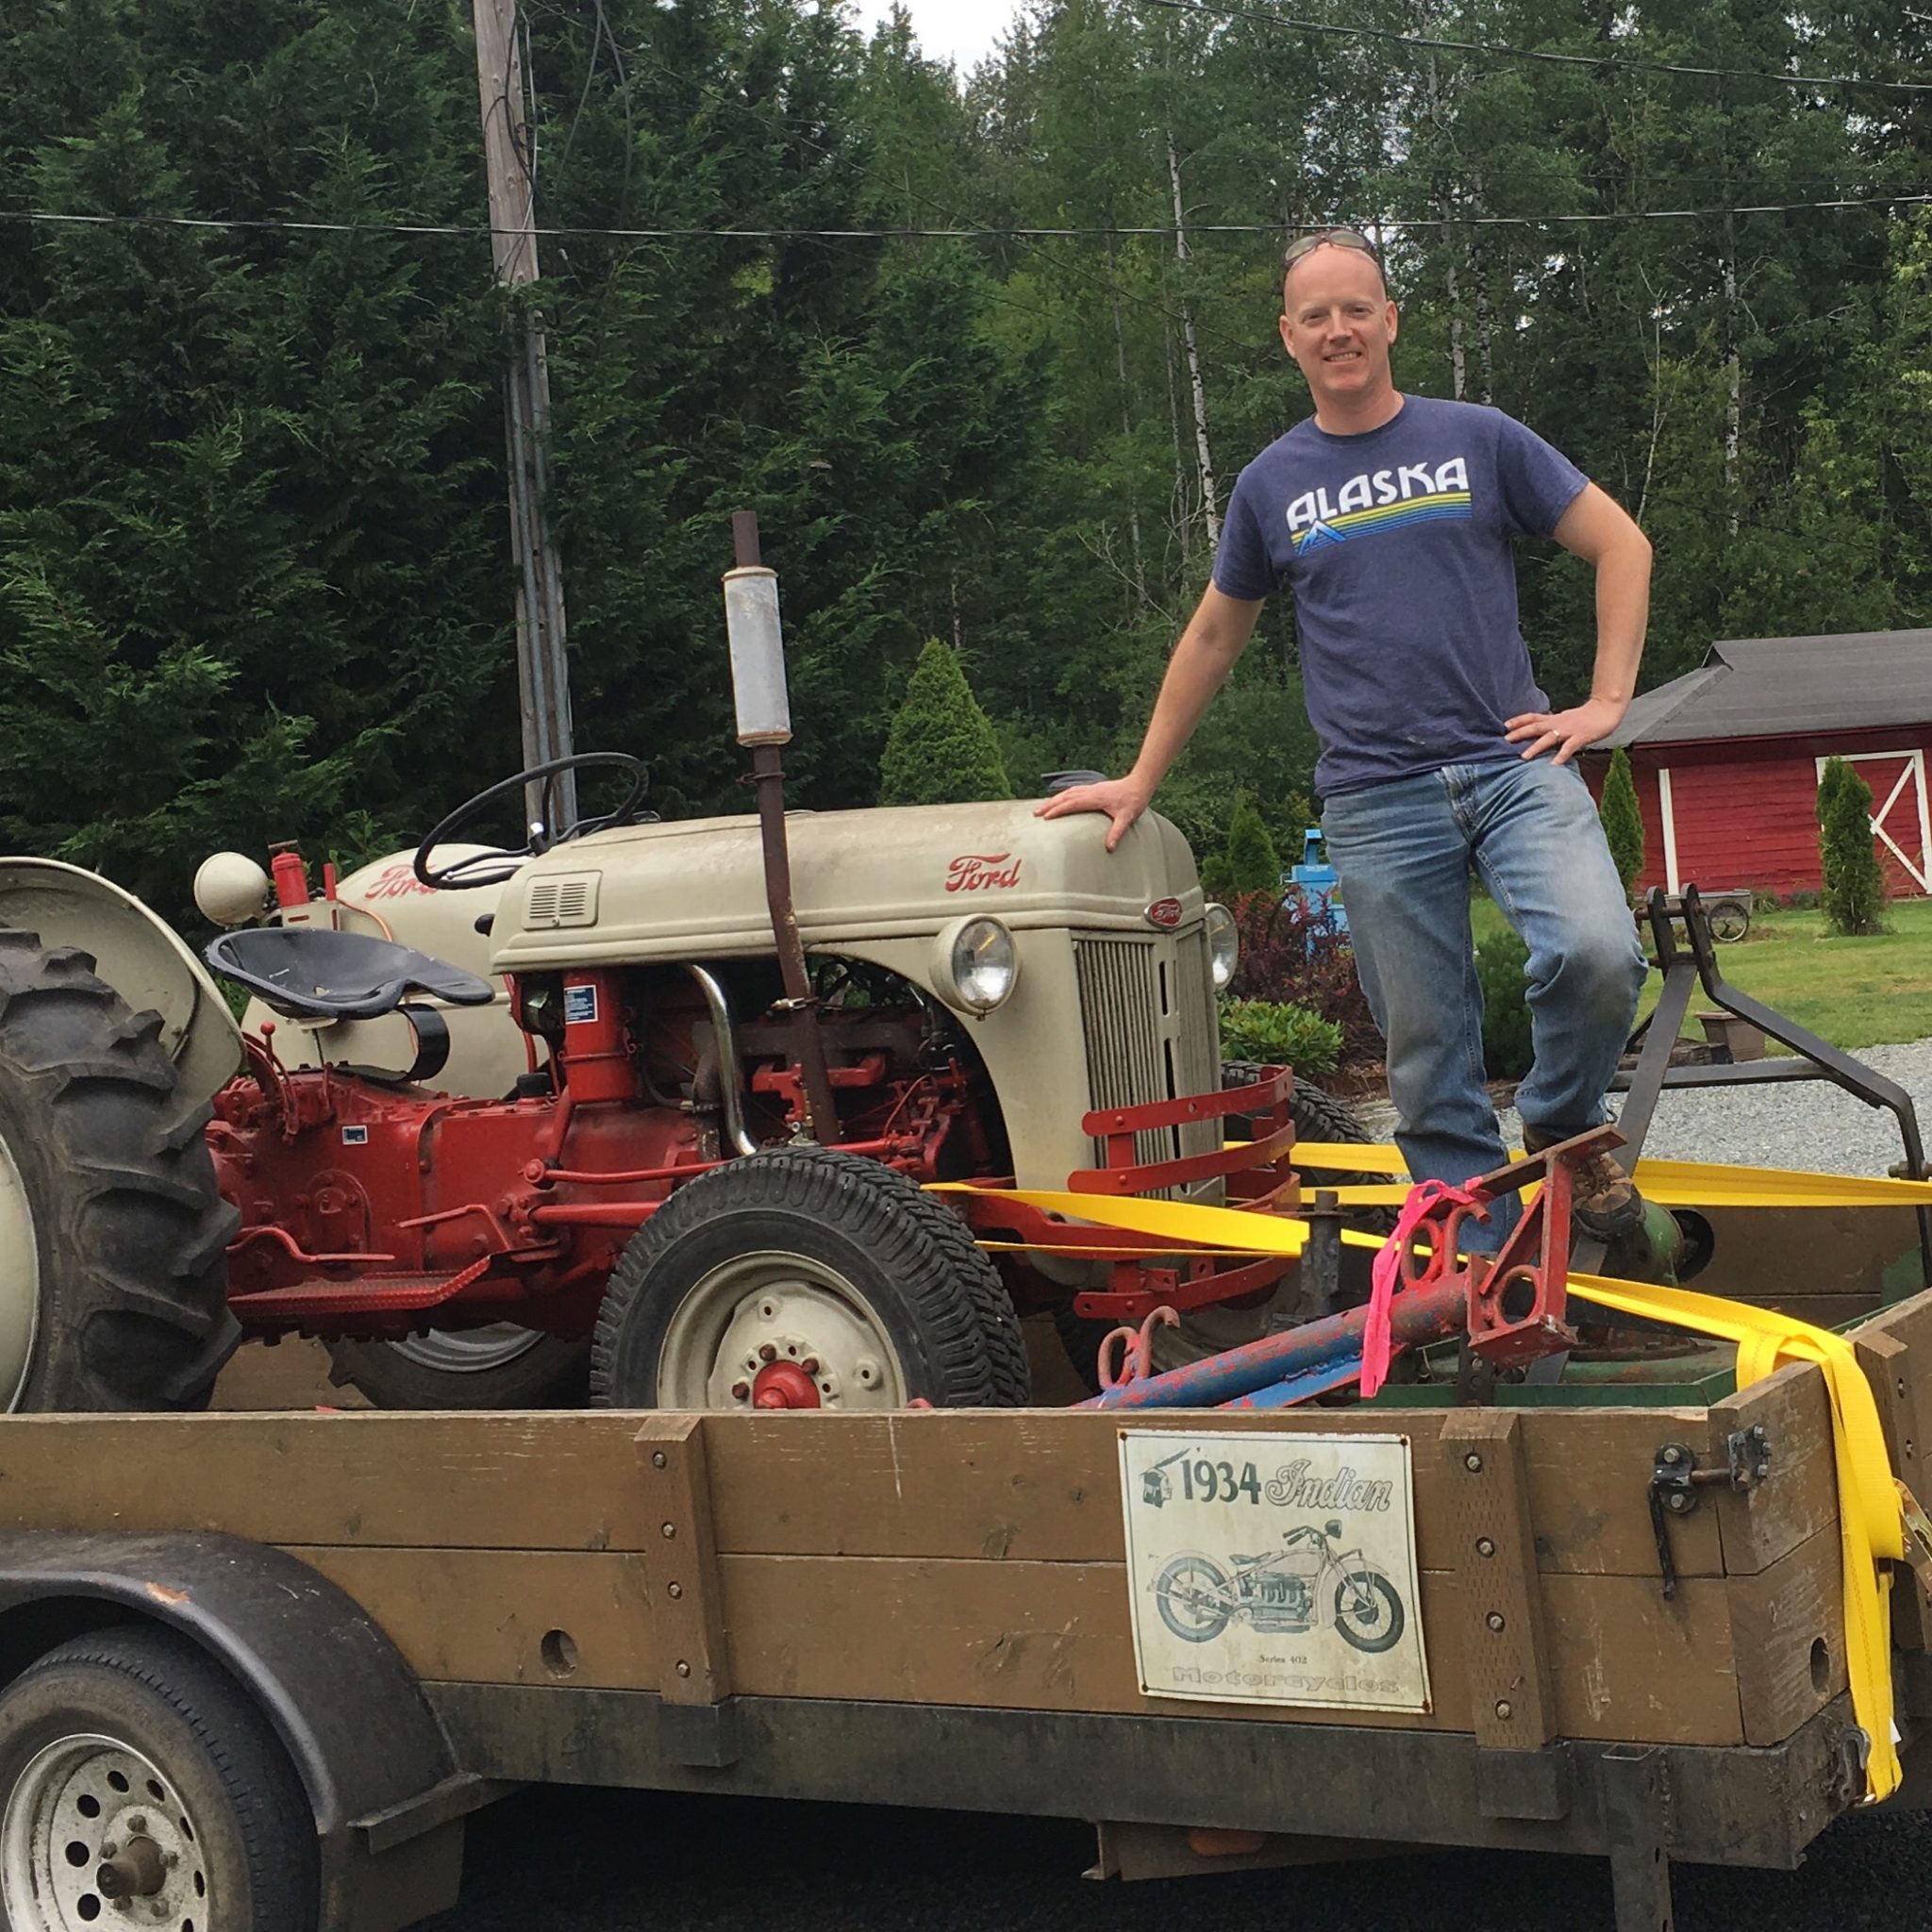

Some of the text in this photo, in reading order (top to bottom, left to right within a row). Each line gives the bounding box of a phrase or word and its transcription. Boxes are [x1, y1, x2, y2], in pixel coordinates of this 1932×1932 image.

[1286, 457, 1470, 531] ALASKA
[945, 853, 1022, 891] Ford
[1179, 1458, 1393, 1511] 1934 Indian
[1259, 1653, 1307, 1665] Series 402
[1173, 1666, 1400, 1693] Motorcycles
